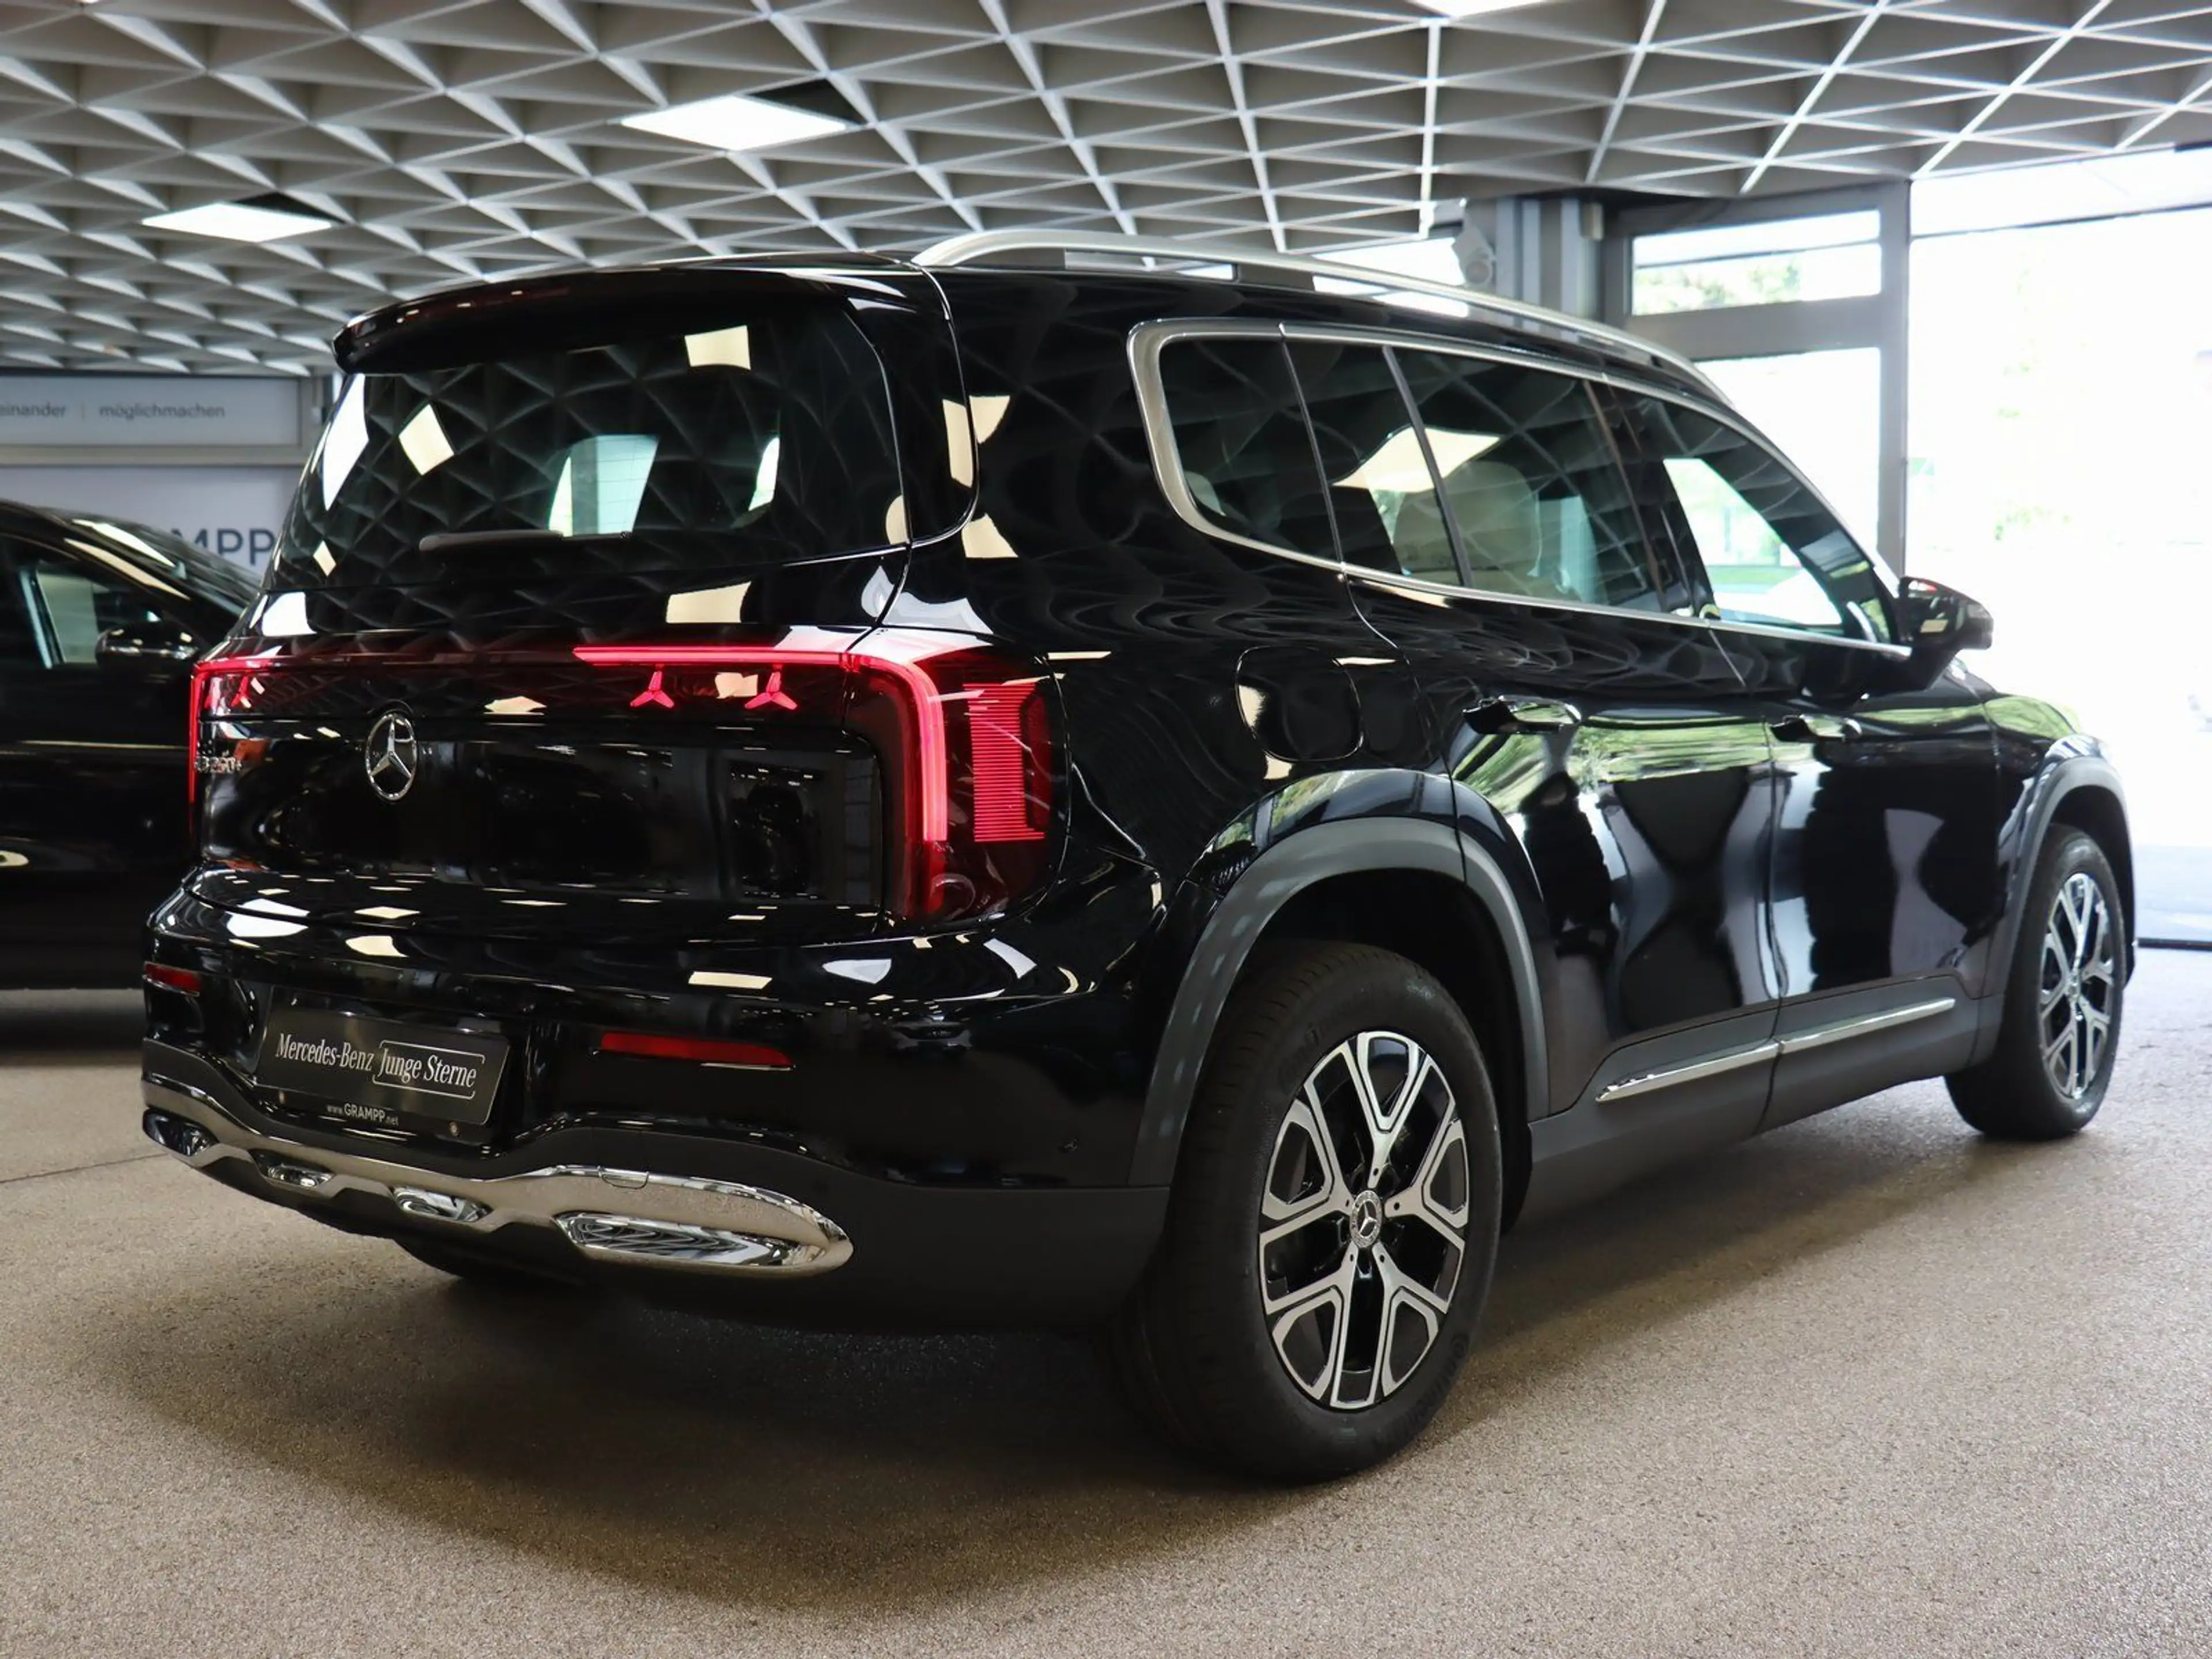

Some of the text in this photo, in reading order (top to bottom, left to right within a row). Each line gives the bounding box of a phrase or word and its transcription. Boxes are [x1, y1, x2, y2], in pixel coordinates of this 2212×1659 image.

[275, 1033, 477, 1088] Mercedes-Benz Junge Sterne
